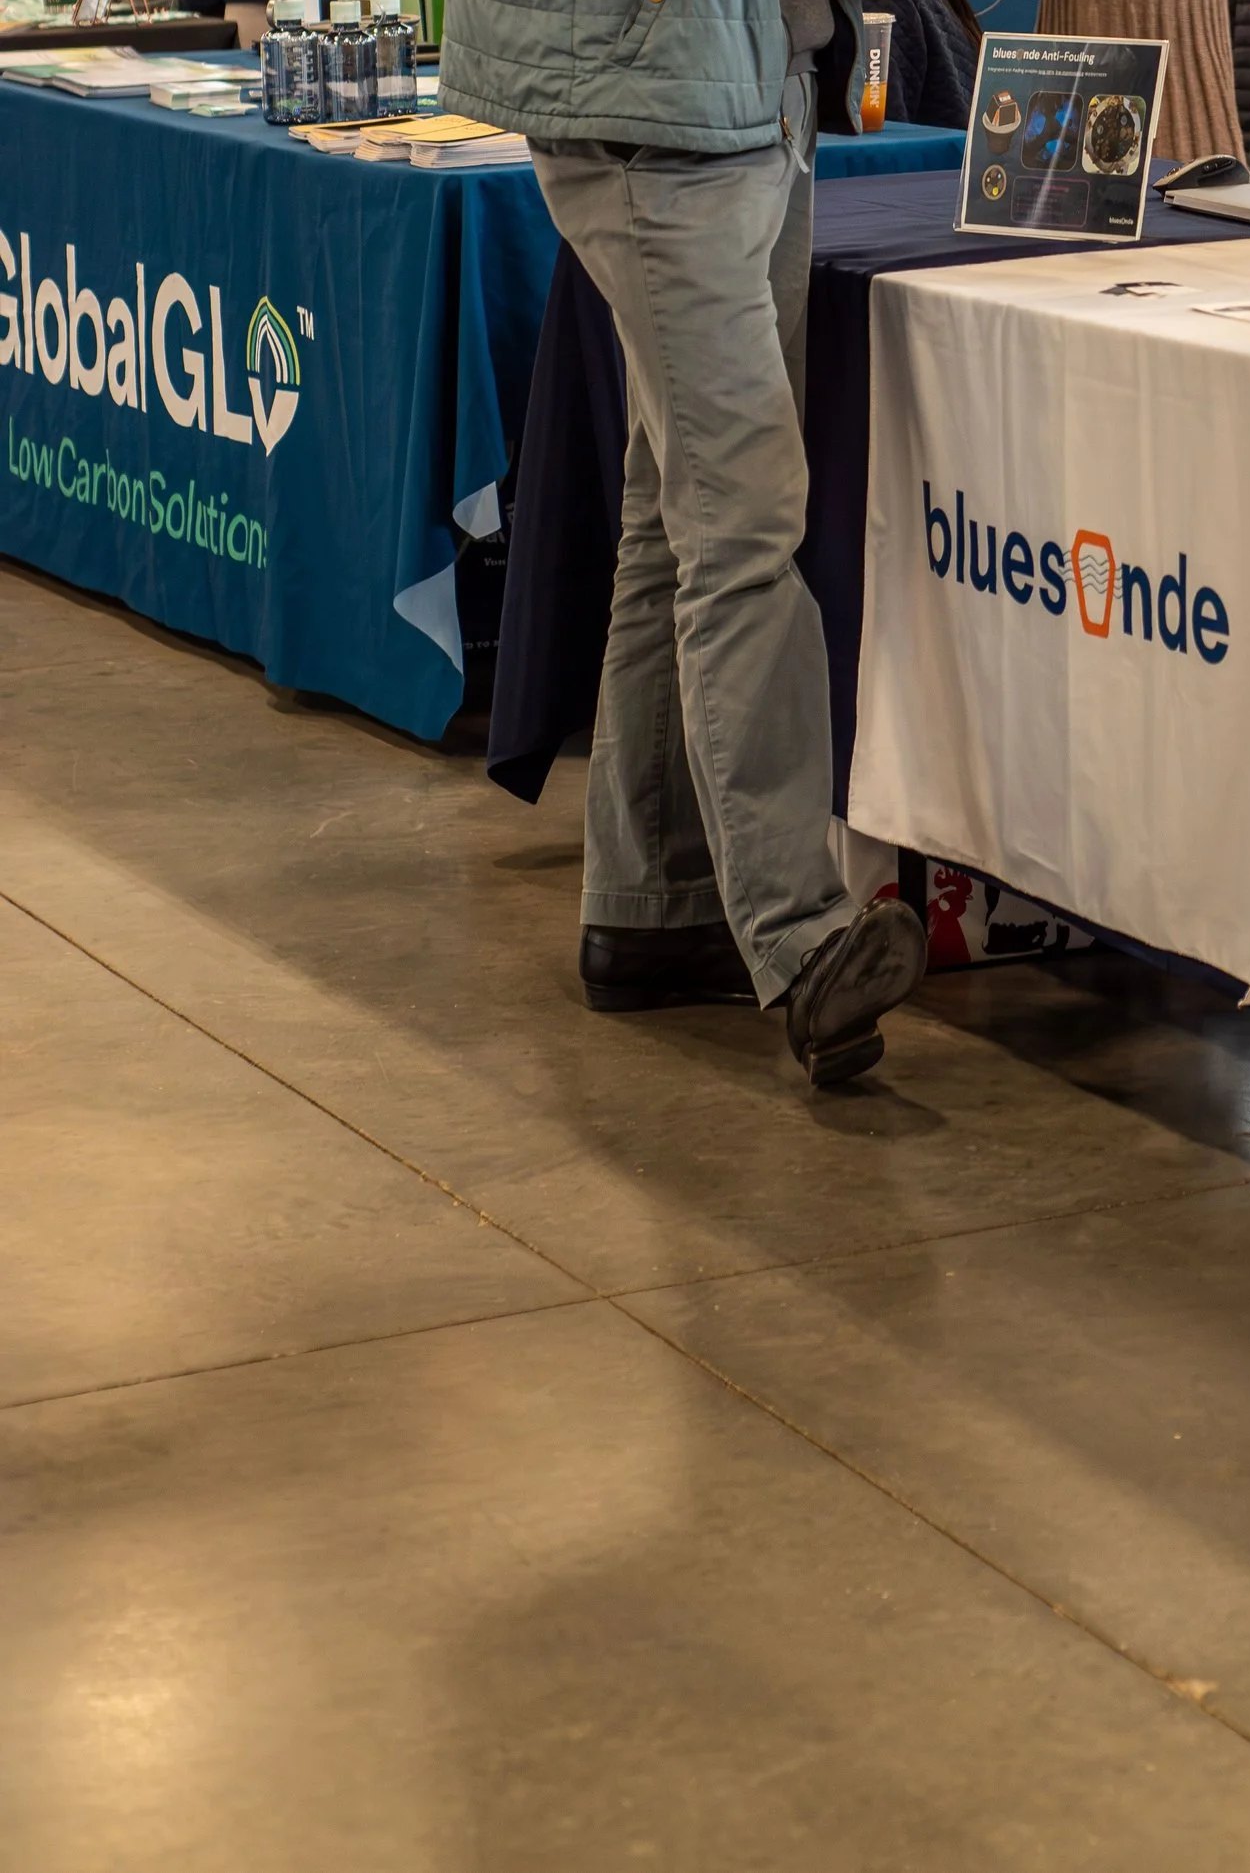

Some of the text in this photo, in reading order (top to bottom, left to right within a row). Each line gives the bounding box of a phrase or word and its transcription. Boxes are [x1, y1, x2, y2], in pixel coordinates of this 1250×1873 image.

[1041, 50, 1095, 65] Anti-Fouling
[9, 415, 53, 489] Low
[57, 436, 146, 527] Carbon
